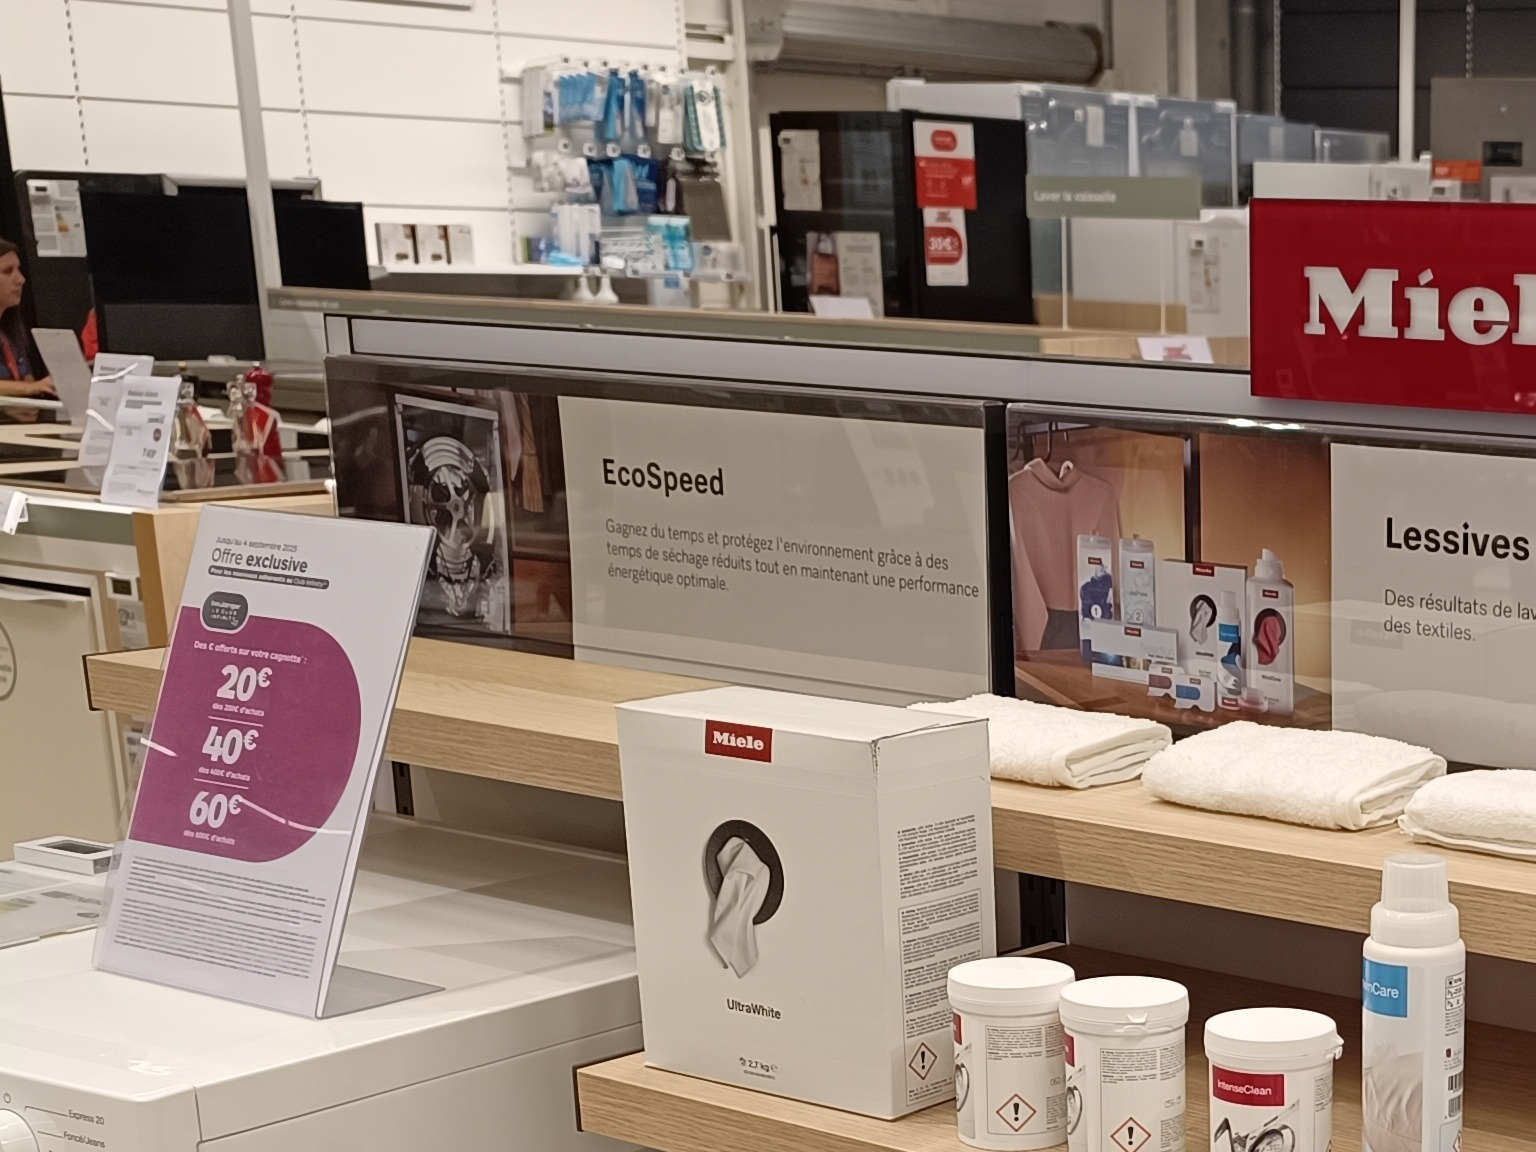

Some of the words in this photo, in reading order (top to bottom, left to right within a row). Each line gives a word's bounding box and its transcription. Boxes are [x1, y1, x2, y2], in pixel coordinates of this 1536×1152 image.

[603, 458, 724, 497] EcoSpeed
[605, 518, 648, 538] Gagnez
[651, 523, 665, 539] du
[668, 526, 704, 544] temps
[708, 533, 719, 546] et
[722, 534, 773, 553] protégez
[777, 538, 874, 562] l'environnement
[877, 549, 911, 567] grâce
[915, 551, 922, 567] à
[926, 554, 948, 570] des
[1385, 517, 1530, 560] Lessives
[212, 548, 243, 565] Offre
[246, 554, 308, 573] exclusive
[607, 542, 642, 560] temps
[645, 546, 659, 560] de
[662, 548, 709, 569] séchage
[712, 552, 752, 572] réduits
[755, 560, 780, 574] tout
[783, 564, 798, 576] en
[800, 564, 869, 586] maintenant
[873, 574, 895, 588] une
[898, 576, 979, 598] performance
[608, 564, 674, 586] énergétique
[677, 573, 729, 591] optimale.
[1384, 589, 1414, 608] Des
[1419, 593, 1488, 615] résultats
[1492, 600, 1512, 618] de
[1383, 615, 1412, 635] des
[1416, 619, 1475, 642] textiles.
[216, 664, 272, 702] 20€
[202, 726, 259, 764] 40€
[713, 730, 764, 751] Miele
[189, 791, 241, 829] 60€
[727, 998, 781, 1020] UltraWhite
[1217, 1079, 1272, 1096] IntenseClean
